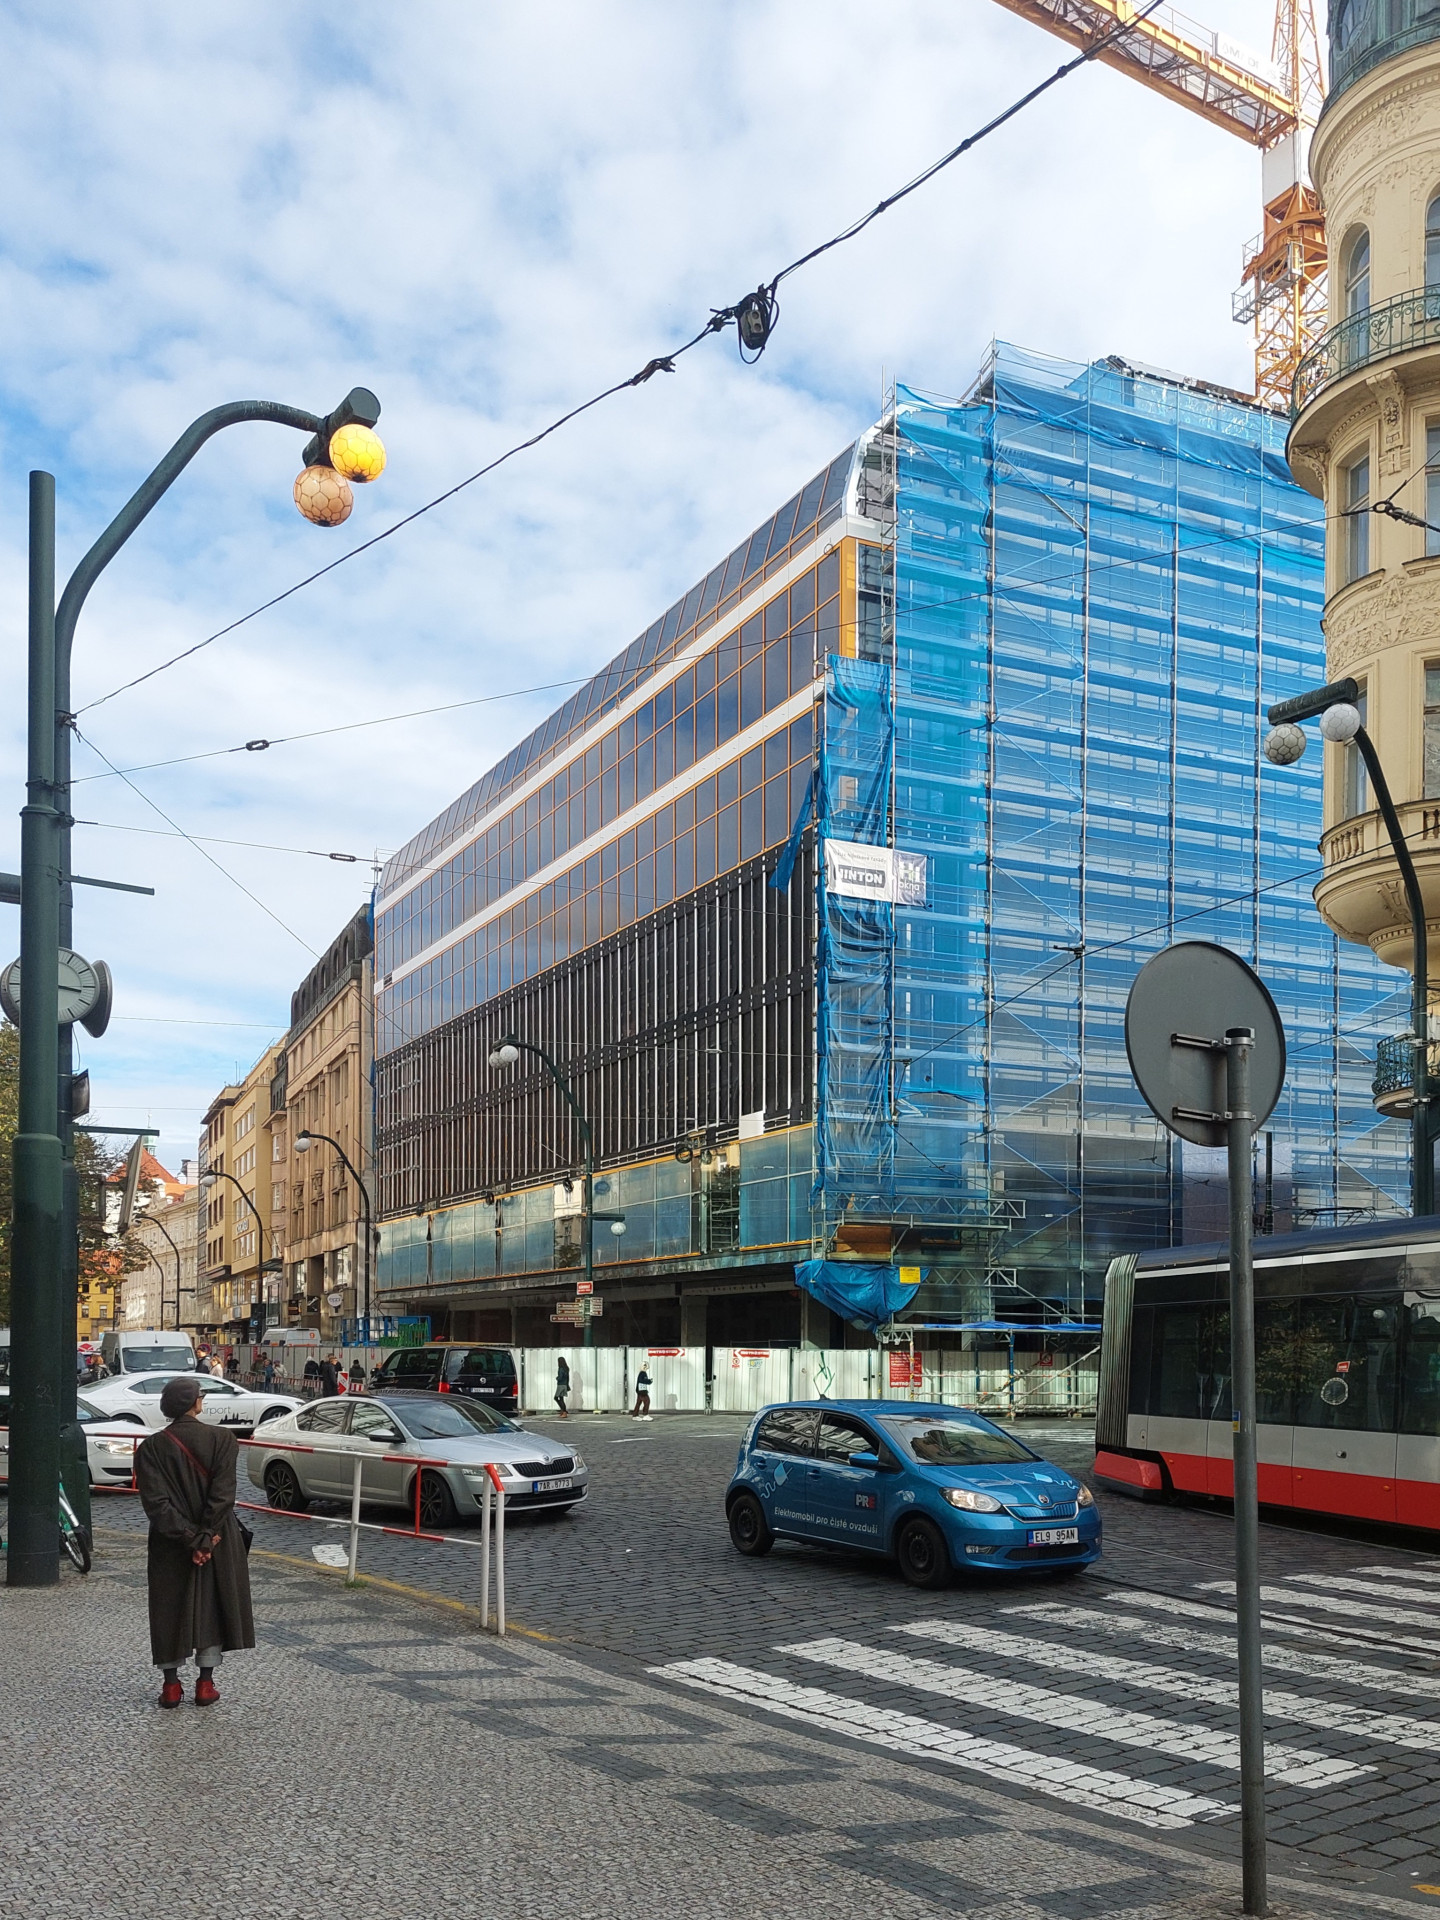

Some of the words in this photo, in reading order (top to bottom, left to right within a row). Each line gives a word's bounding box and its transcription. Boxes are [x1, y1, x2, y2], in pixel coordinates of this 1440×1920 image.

[855, 1494, 875, 1509] PRE
[774, 1506, 815, 1522] Elektromobil
[816, 1516, 828, 1525] pro
[829, 1516, 848, 1528] čisté
[849, 1521, 878, 1534] ovzduší
[1035, 1531, 1051, 1542] EL9
[1056, 1529, 1075, 1541] 95AN
